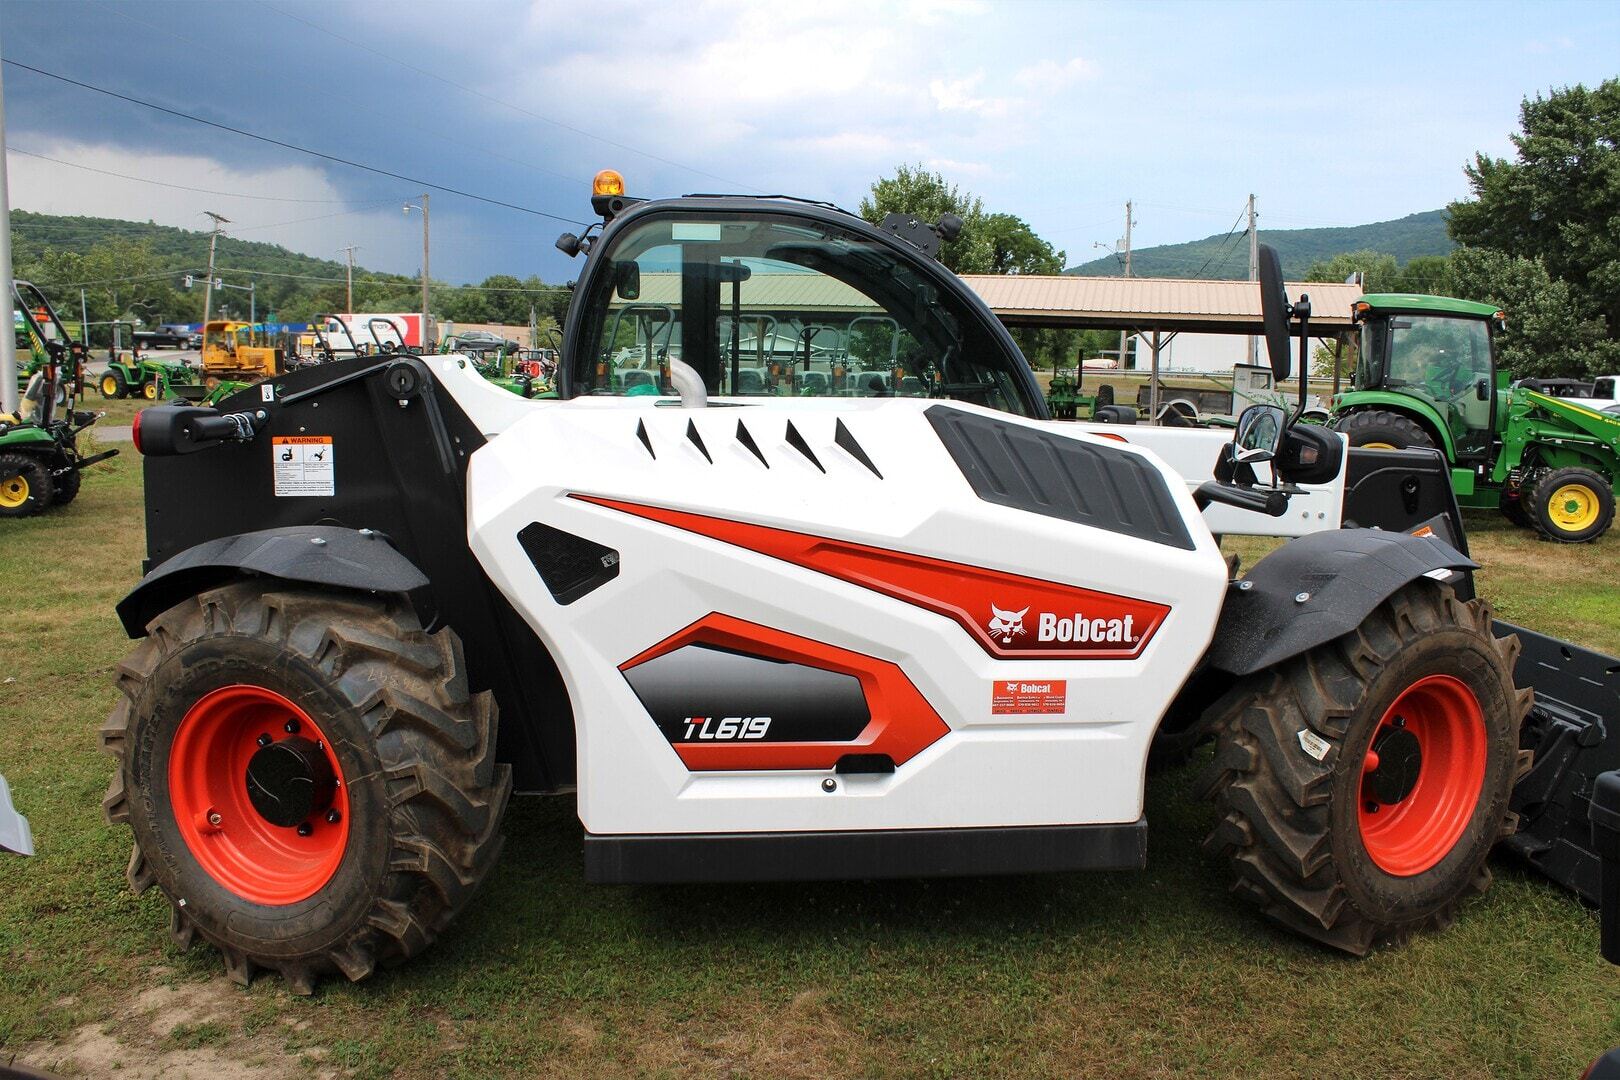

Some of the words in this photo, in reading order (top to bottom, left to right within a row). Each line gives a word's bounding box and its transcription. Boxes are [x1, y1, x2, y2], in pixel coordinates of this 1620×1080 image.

[1038, 612, 1134, 642] Bobcat
[1020, 683, 1051, 693] Bobcat
[683, 717, 772, 739] TL619
